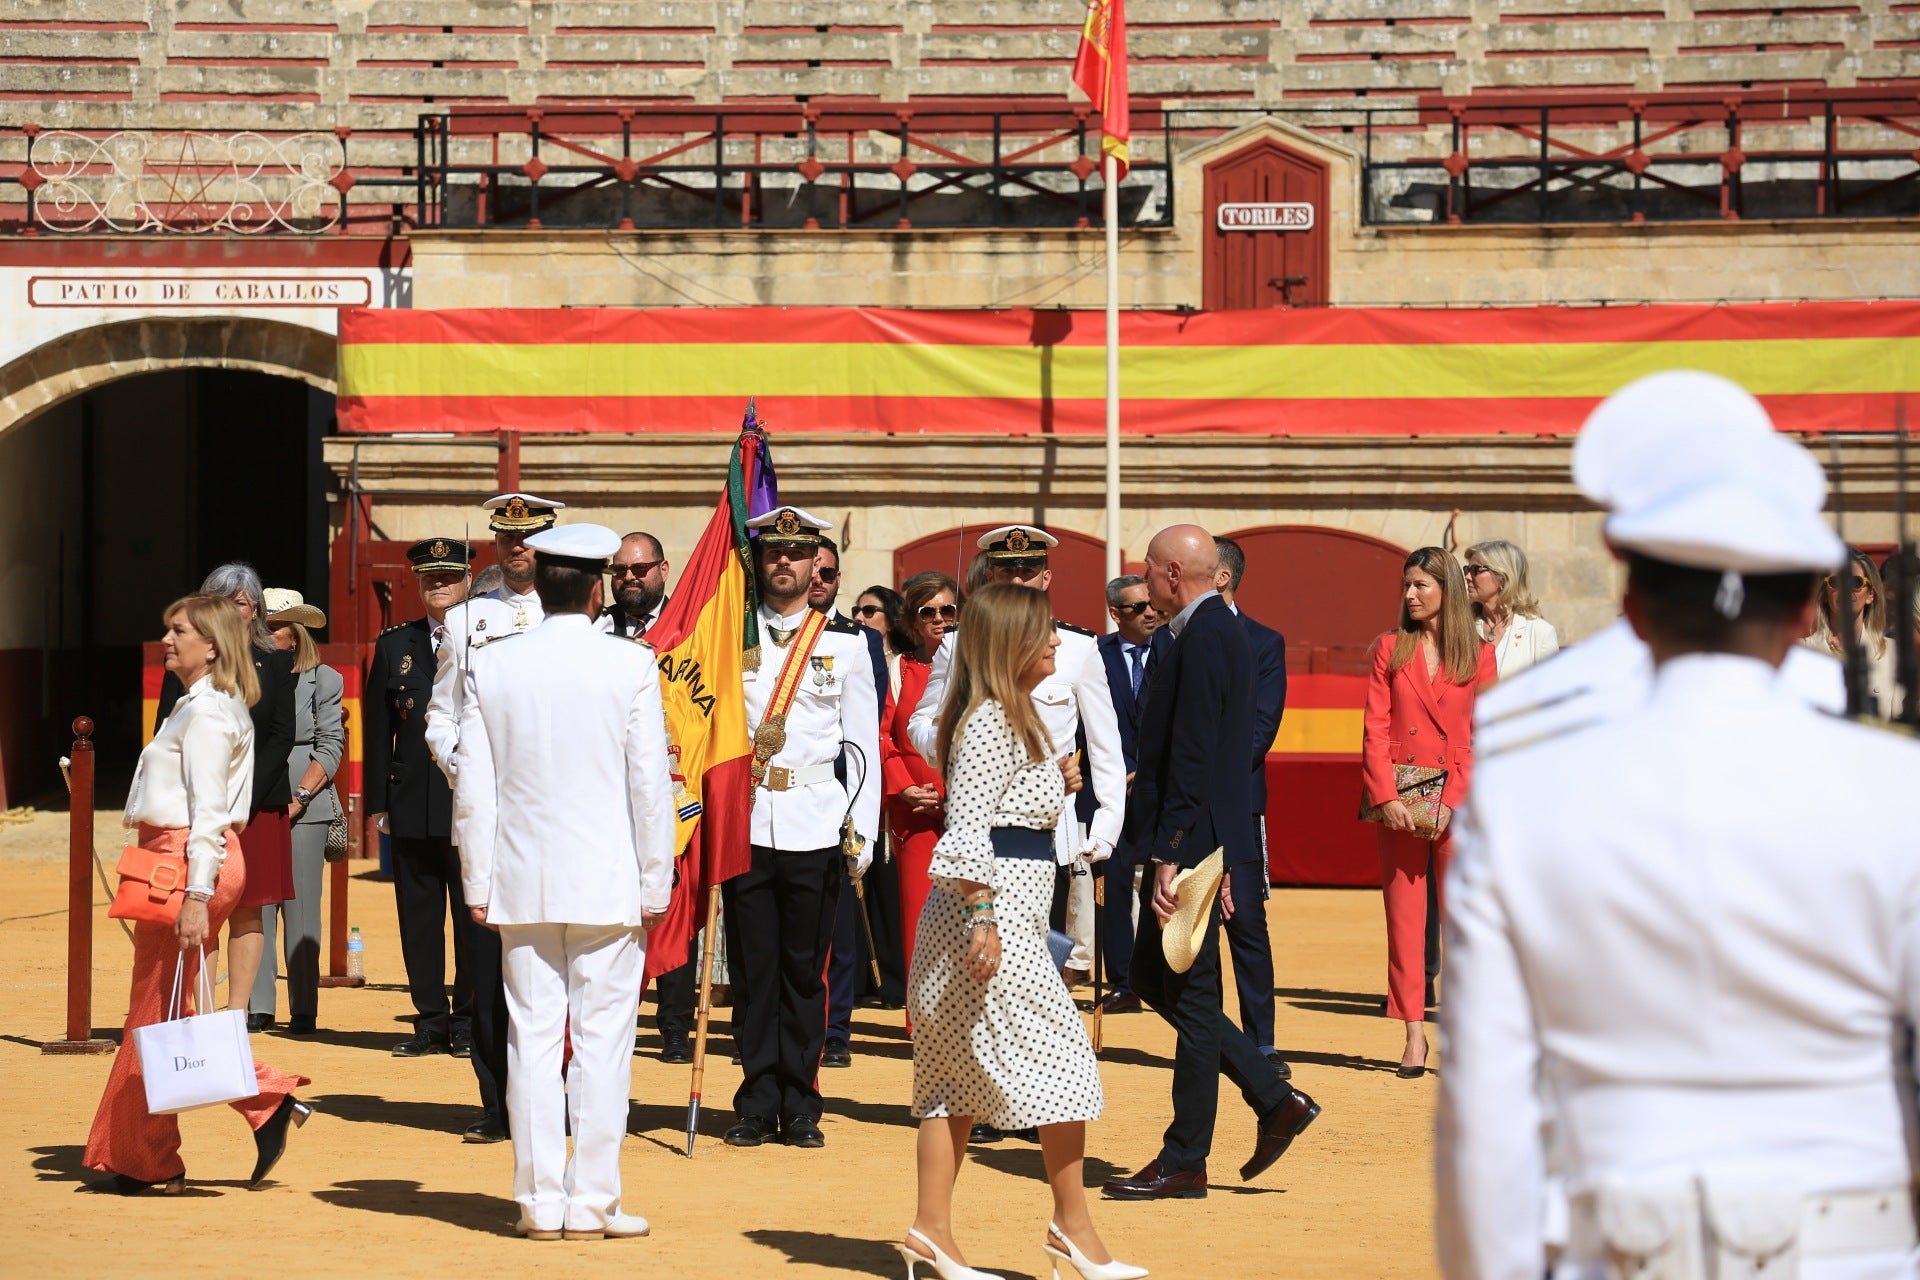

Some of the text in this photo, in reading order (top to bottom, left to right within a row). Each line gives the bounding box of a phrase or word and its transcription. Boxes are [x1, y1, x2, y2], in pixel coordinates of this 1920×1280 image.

[1225, 207, 1308, 224] TORILES
[61, 283, 340, 300] PATIO DE CABALLOS
[657, 654, 716, 718] ARINA
[174, 1056, 206, 1072] Dior
